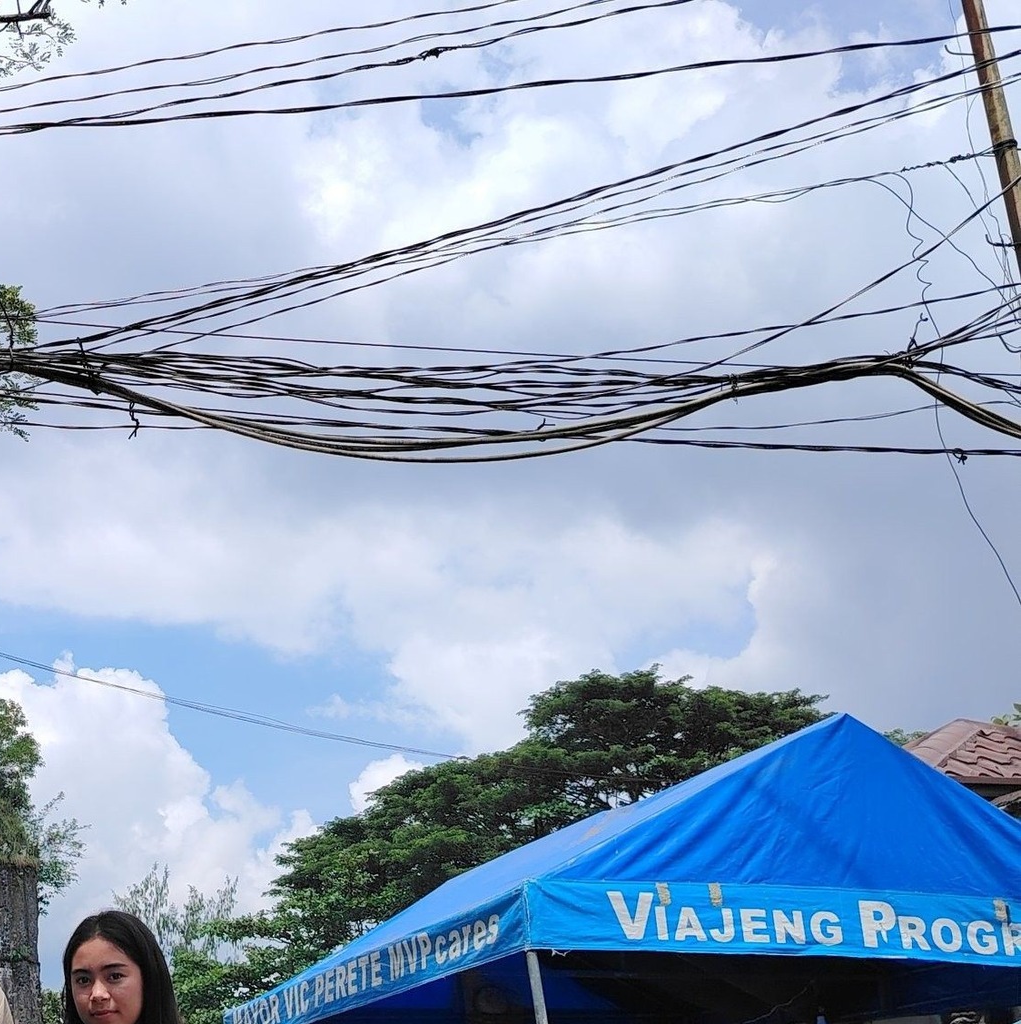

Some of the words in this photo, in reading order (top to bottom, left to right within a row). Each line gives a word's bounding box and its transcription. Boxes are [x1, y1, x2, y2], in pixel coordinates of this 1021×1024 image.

[606, 890, 843, 947] VIAJENG
[282, 981, 310, 1018] VIC
[313, 949, 383, 1006] PERETE
